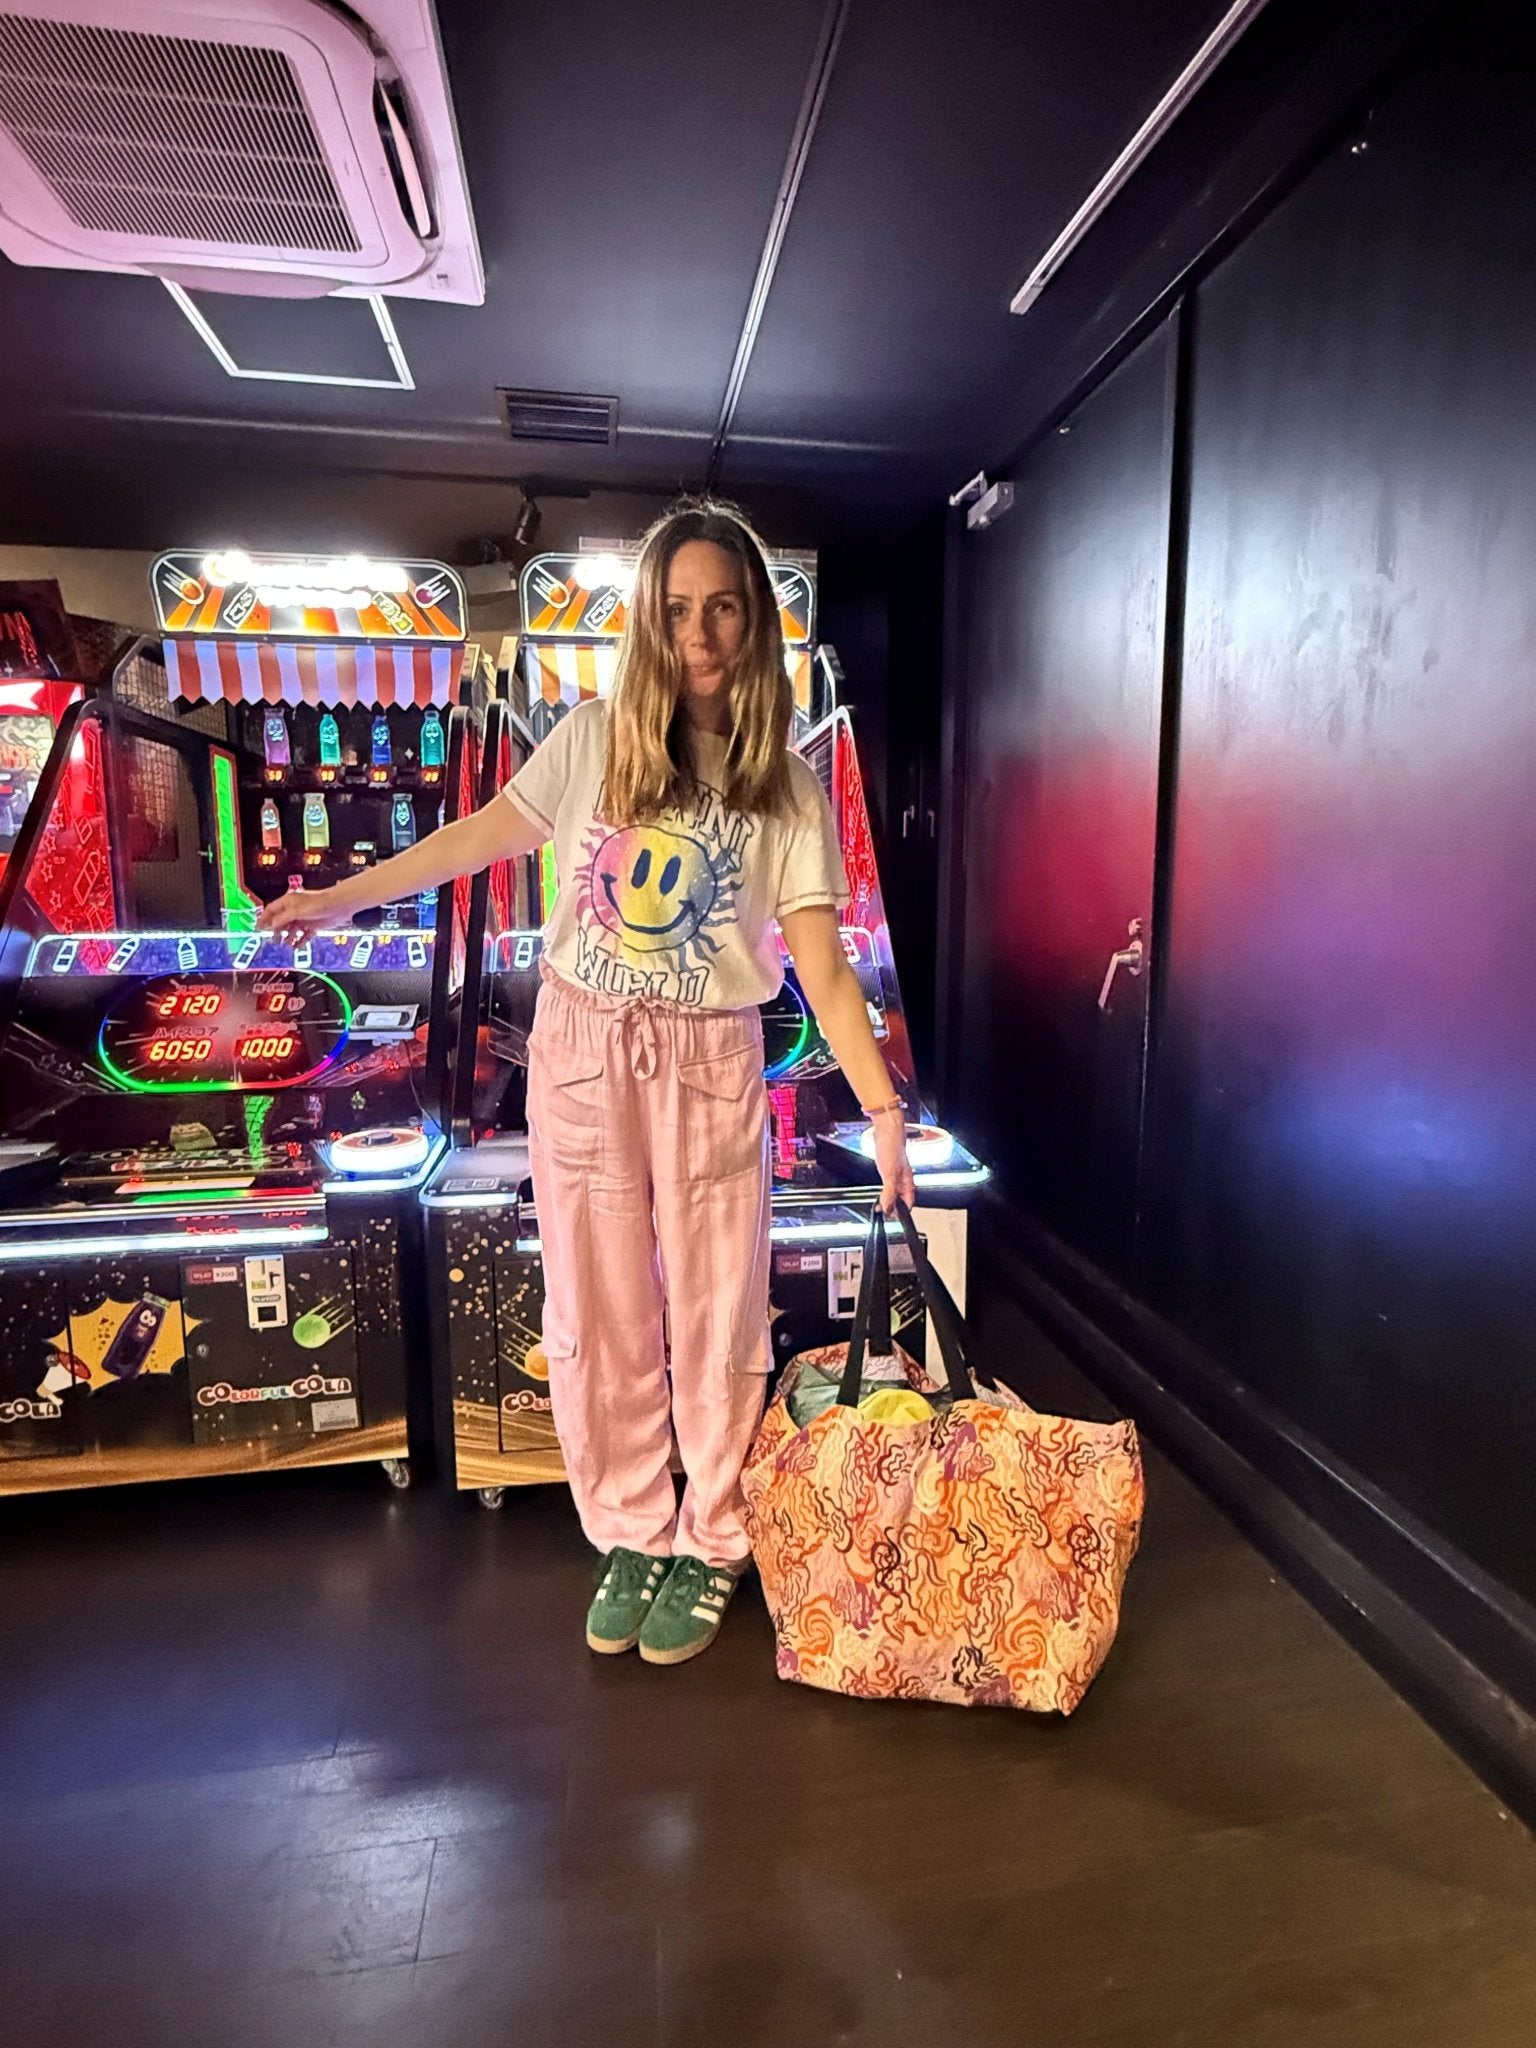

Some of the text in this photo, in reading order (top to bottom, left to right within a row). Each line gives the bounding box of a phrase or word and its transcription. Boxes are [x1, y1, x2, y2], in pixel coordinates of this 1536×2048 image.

[159, 994, 221, 1016] 2120
[269, 994, 286, 1013] 0
[150, 1039, 212, 1061] 6050
[240, 1037, 293, 1058] 1000
[197, 1374, 352, 1406] COLORFUL COLA
[0, 1398, 61, 1423] COLA
